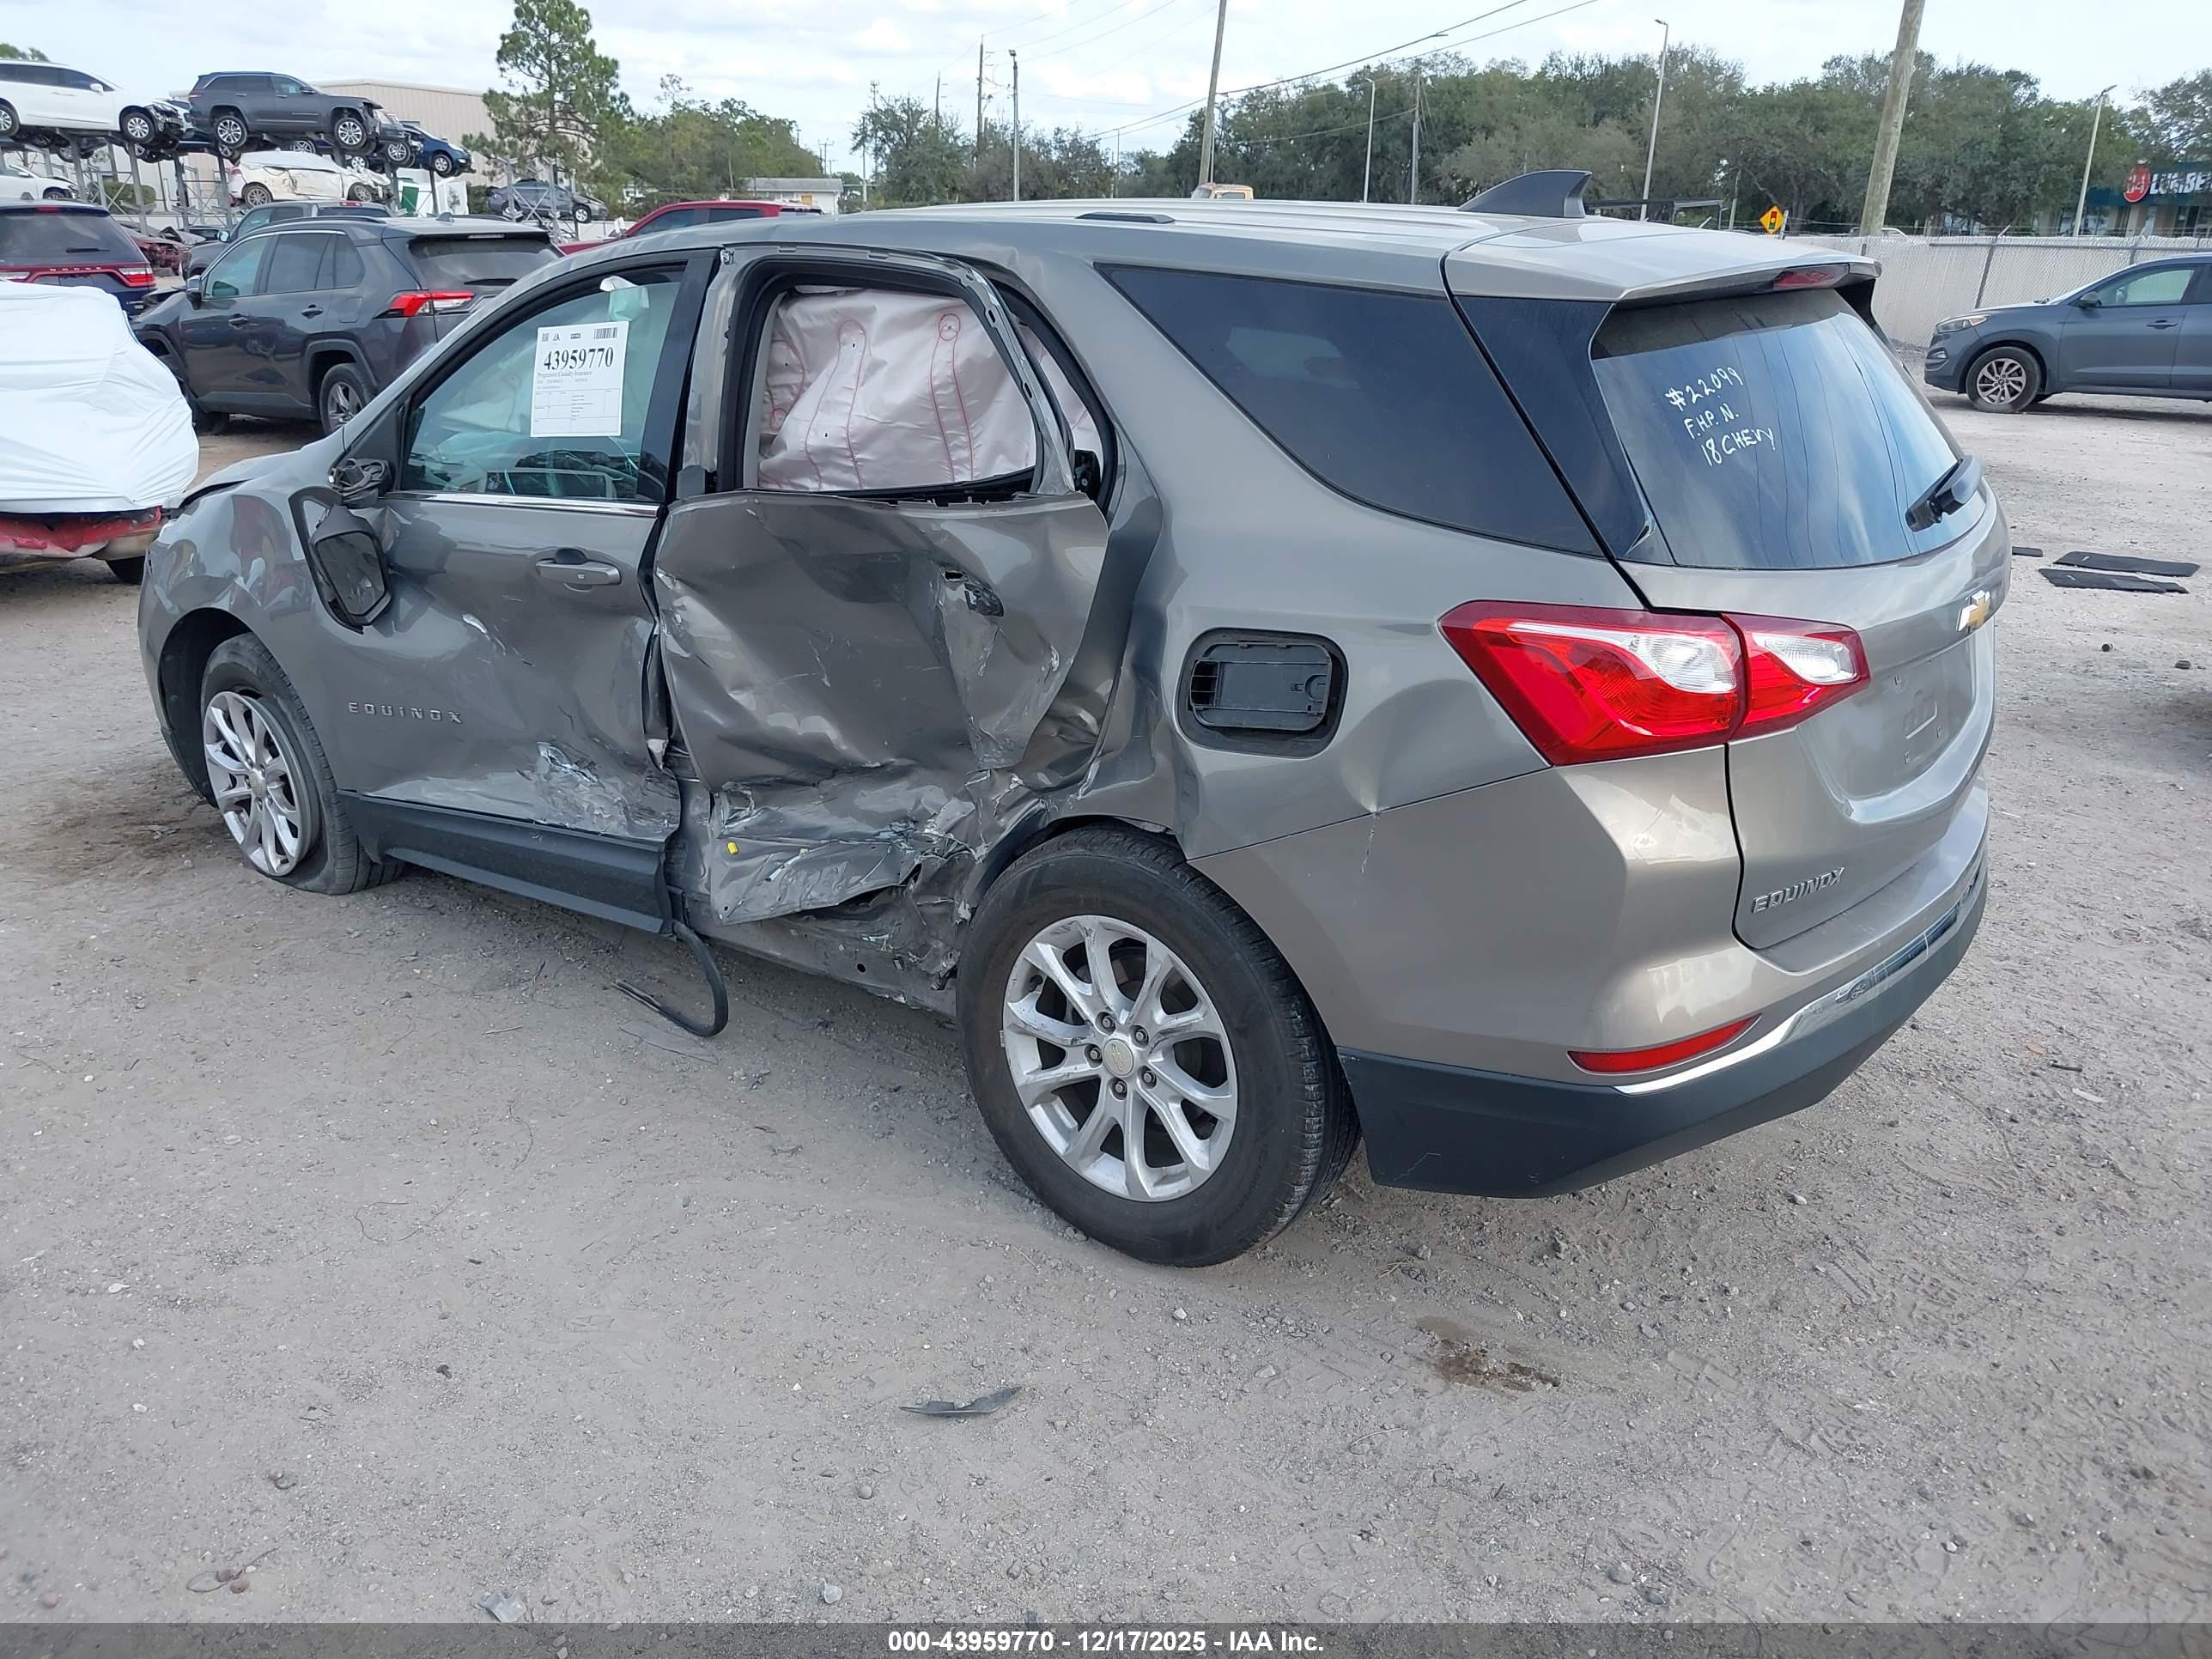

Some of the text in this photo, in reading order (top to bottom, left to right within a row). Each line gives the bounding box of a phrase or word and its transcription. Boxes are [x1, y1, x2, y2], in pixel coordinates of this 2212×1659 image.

[544, 346, 614, 371] 43959770
[348, 702, 462, 723] EQUINOX
[1752, 866, 1844, 913] EQUINOX
